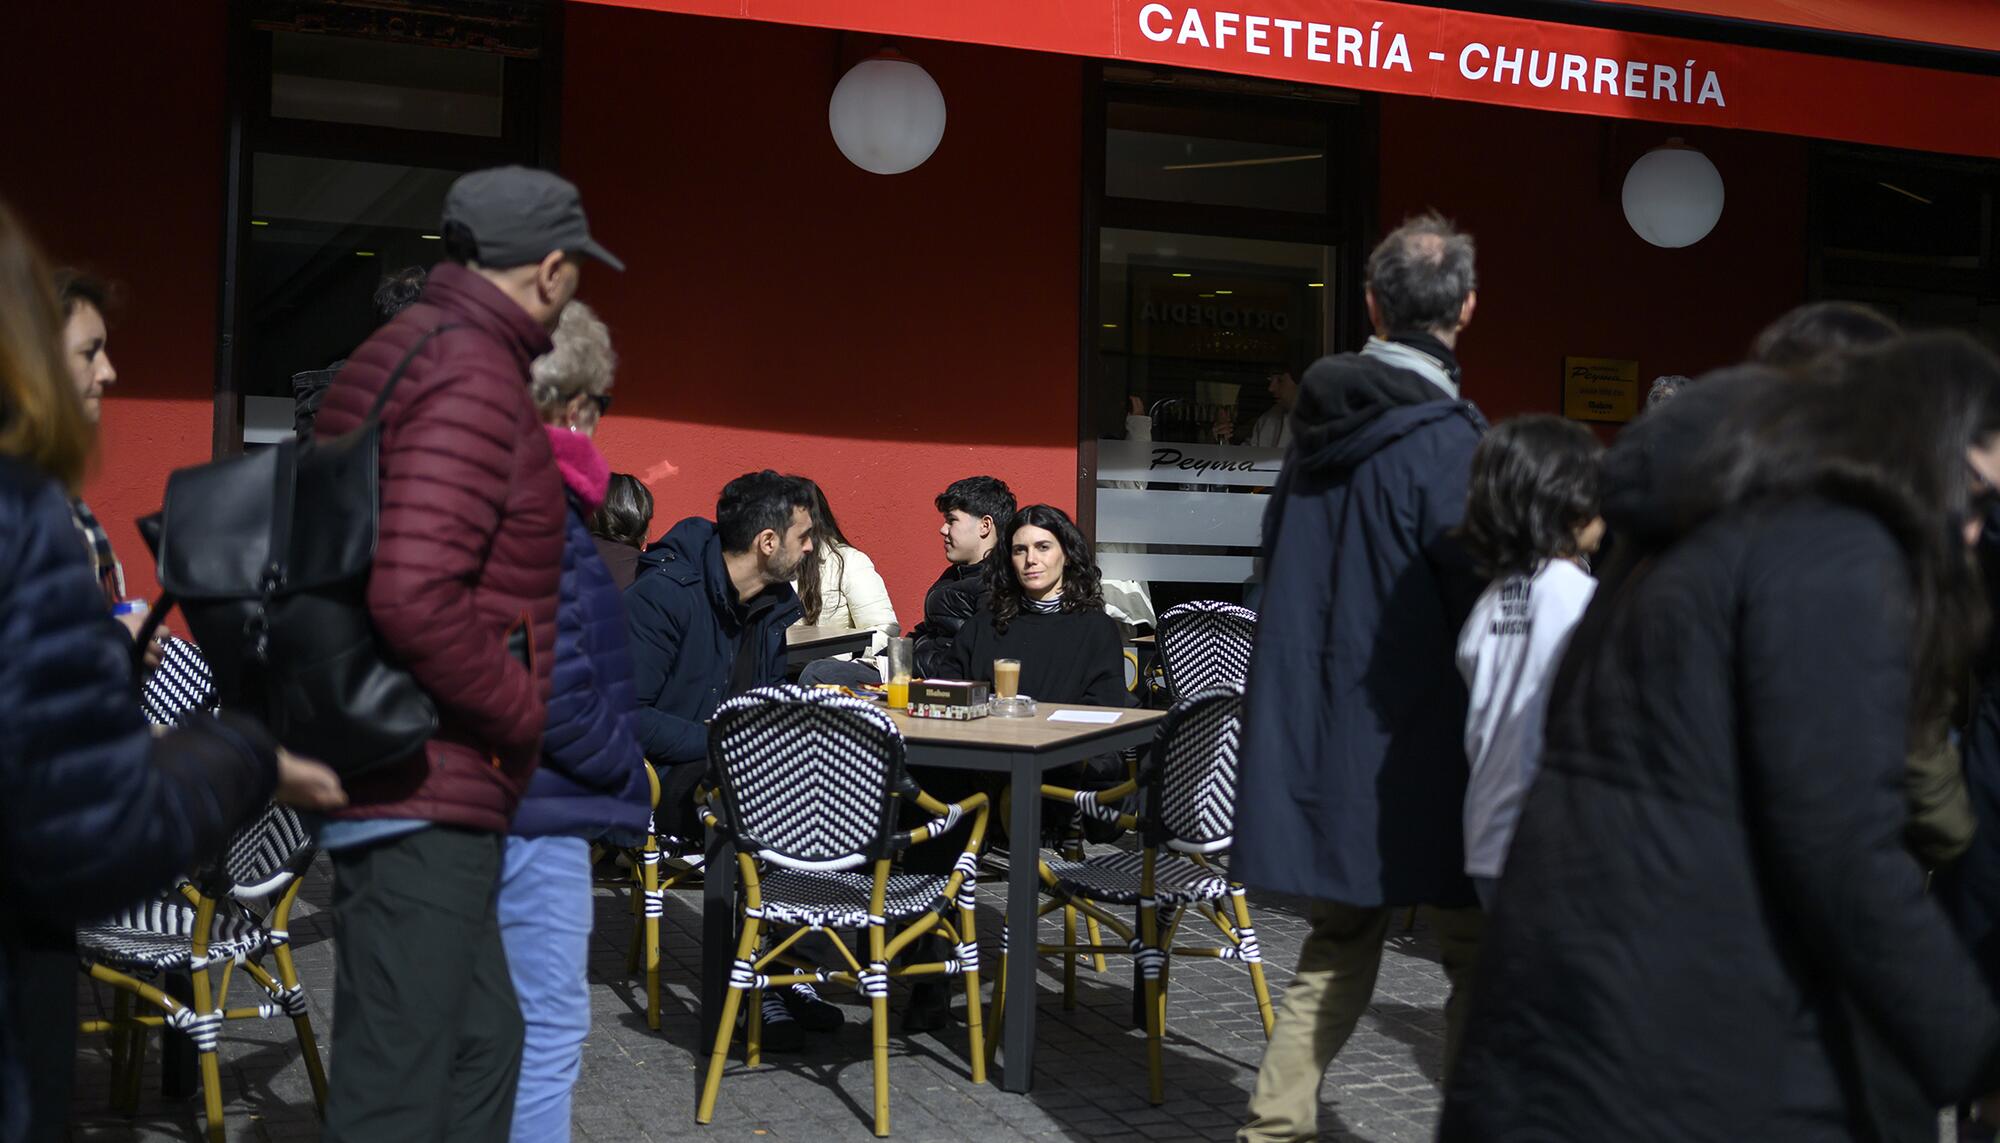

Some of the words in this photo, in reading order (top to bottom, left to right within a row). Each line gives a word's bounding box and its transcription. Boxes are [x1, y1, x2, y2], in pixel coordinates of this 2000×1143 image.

[1138, 3, 1413, 73] CAFETERÍA
[1458, 42, 1726, 107] CHURRERÍA
[1150, 447, 1265, 478] Peyma
